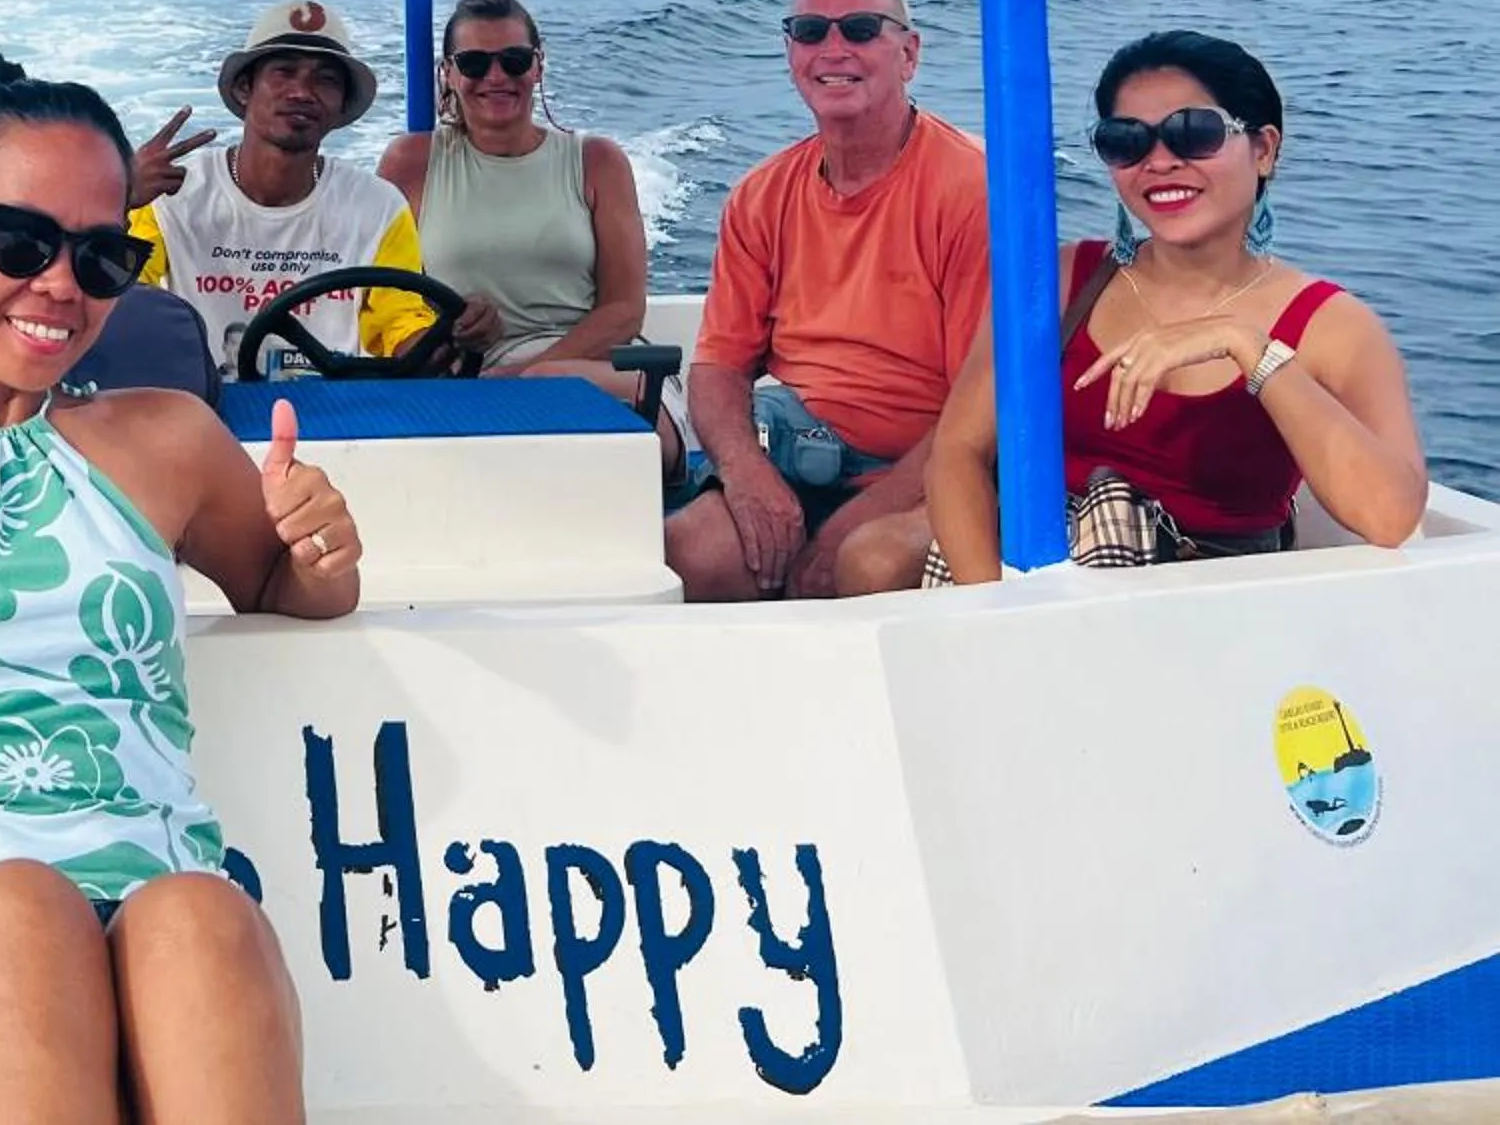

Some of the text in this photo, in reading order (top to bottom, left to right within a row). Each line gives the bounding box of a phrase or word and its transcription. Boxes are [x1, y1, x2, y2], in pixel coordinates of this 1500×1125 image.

[211, 246, 343, 264] Don't compromise,
[251, 261, 311, 275] use only
[195, 276, 255, 294] 100%
[301, 720, 843, 1096] Happy
